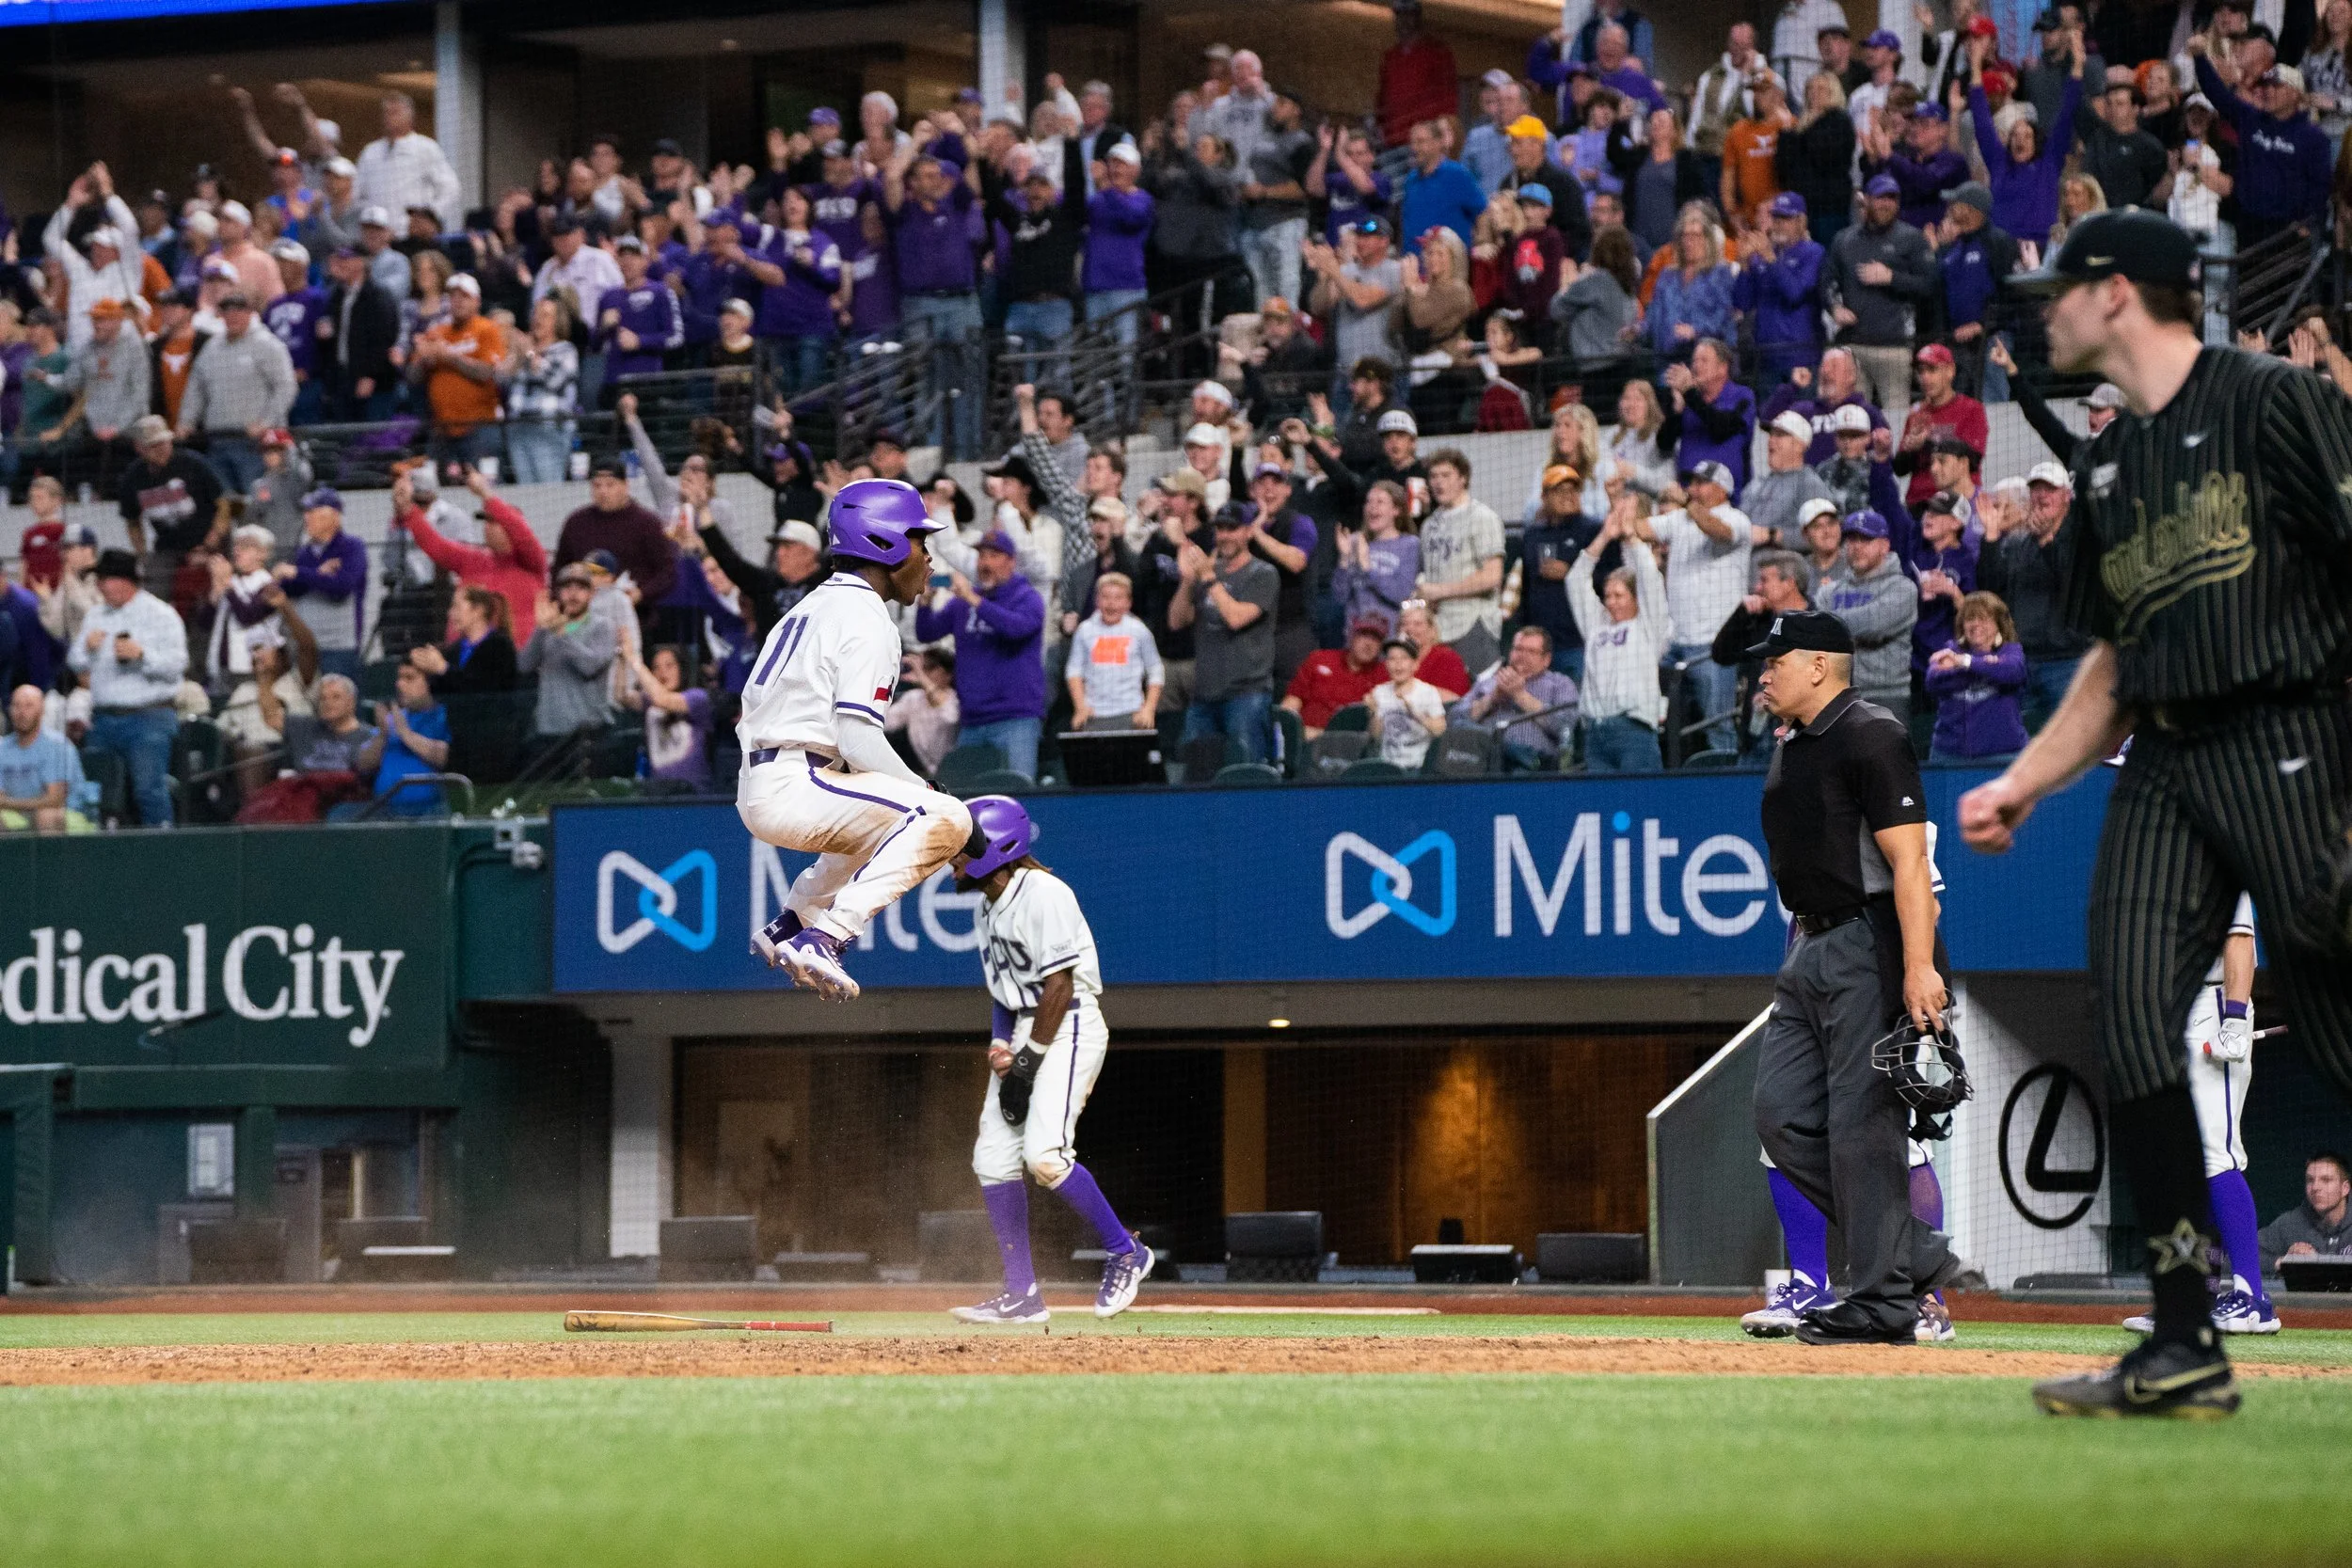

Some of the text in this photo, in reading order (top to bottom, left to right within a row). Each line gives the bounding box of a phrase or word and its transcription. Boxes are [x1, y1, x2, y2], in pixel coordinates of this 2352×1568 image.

[755, 616, 809, 688] 11
[1494, 810, 1793, 937] Mite
[0, 922, 405, 1048] dical City
